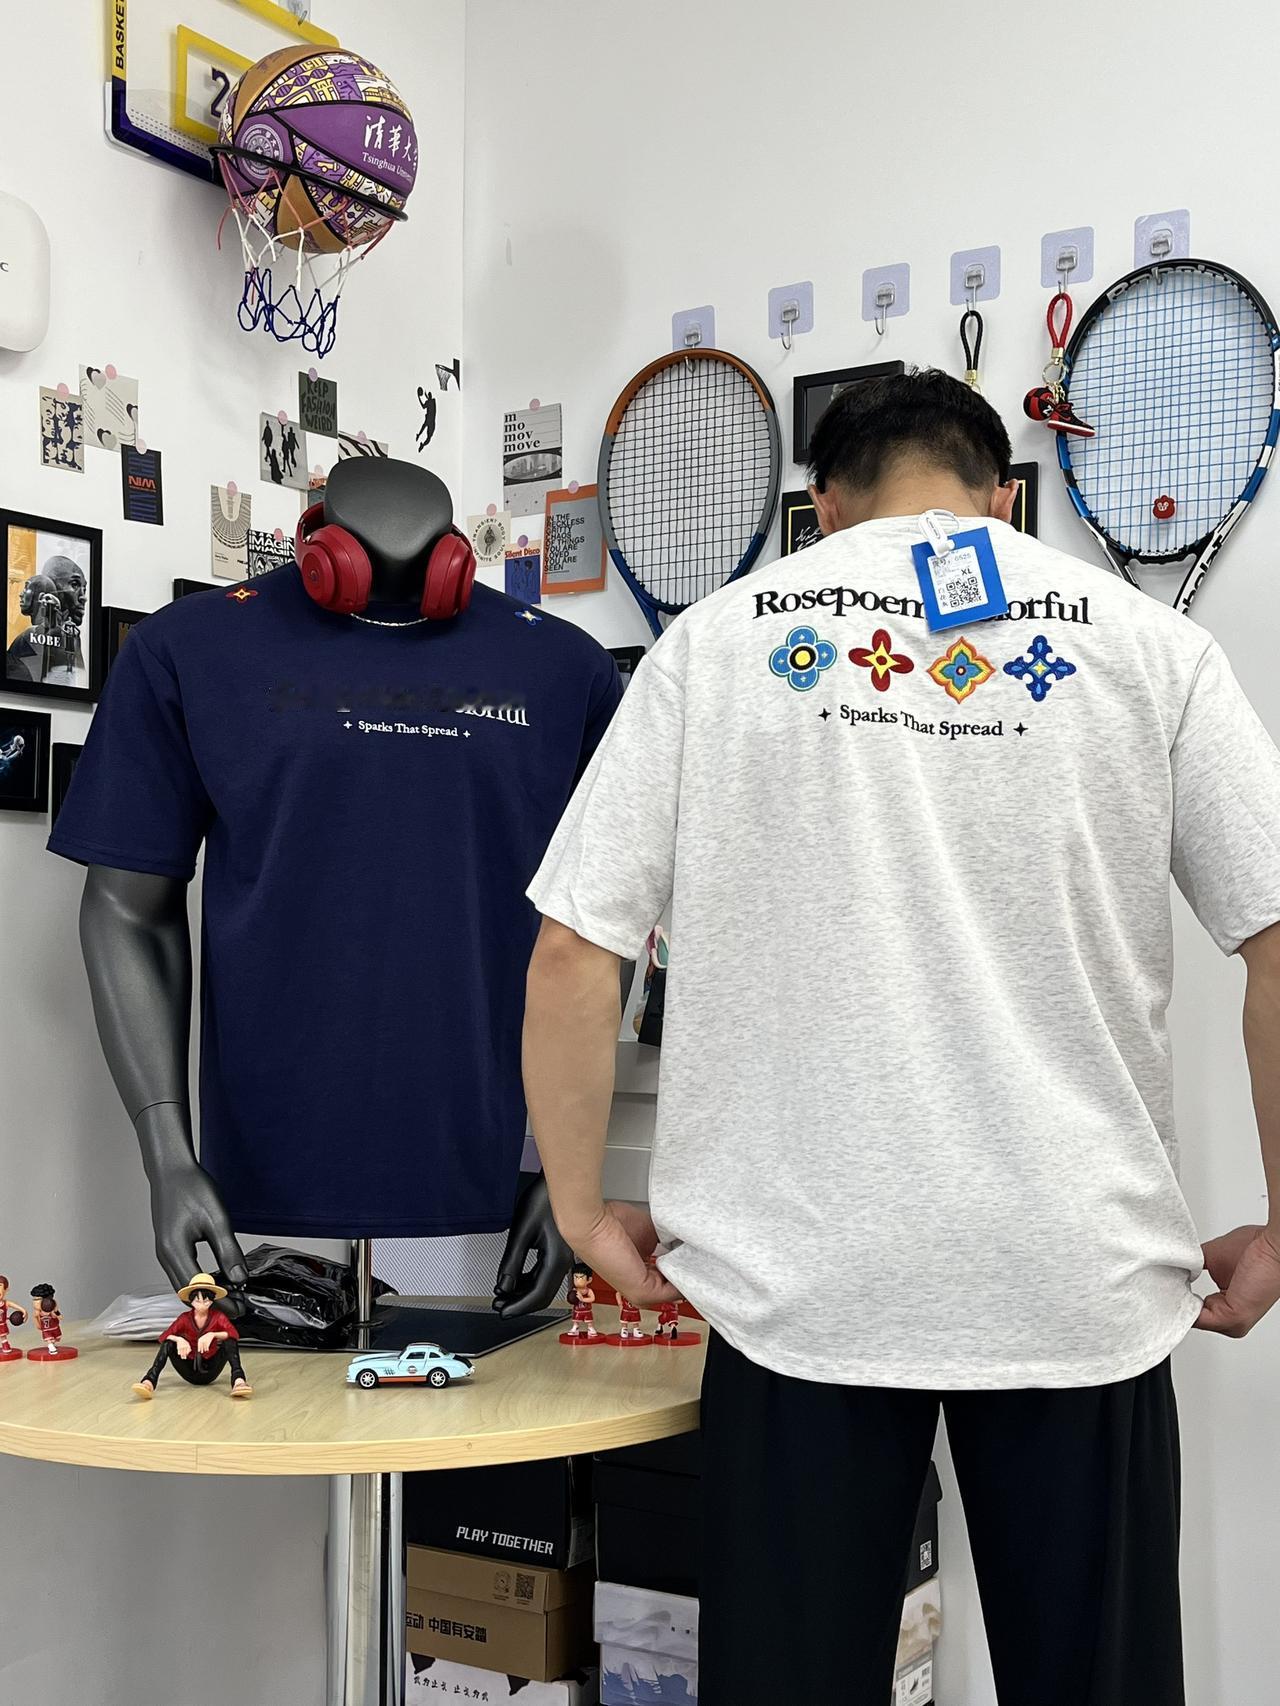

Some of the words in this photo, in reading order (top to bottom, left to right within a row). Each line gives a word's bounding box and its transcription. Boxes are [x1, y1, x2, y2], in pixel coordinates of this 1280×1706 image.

[115, 0, 125, 70] BASKE
[362, 151, 396, 172] Tsinghua
[300, 392, 336, 420] FASHION
[305, 413, 332, 431] WEIRD
[504, 413, 517, 423] m
[504, 422, 525, 433] mo
[504, 430, 533, 443] mov
[504, 440, 541, 452] move
[546, 517, 585, 527] RECKLESS
[545, 531, 572, 541] CHAOS
[546, 525, 572, 535] GRITTY
[557, 536, 585, 545] THINGS
[504, 550, 522, 559] Silent
[523, 547, 541, 556] Disco
[545, 545, 561, 553] YOU
[562, 543, 578, 551] ARE
[544, 550, 570, 560] LOVED
[562, 556, 577, 564] ARE
[961, 568, 973, 576] XL
[998, 591, 1093, 625] orful
[29, 632, 61, 647] KOBE
[840, 703, 898, 725] Sparks
[900, 711, 935, 735] That
[939, 720, 1004, 740] Spread
[358, 720, 393, 733] Sparks
[394, 722, 420, 734] That
[421, 724, 459, 738] Spread
[456, 1526, 489, 1544] PLAY
[491, 1531, 554, 1556] TOGETHER
